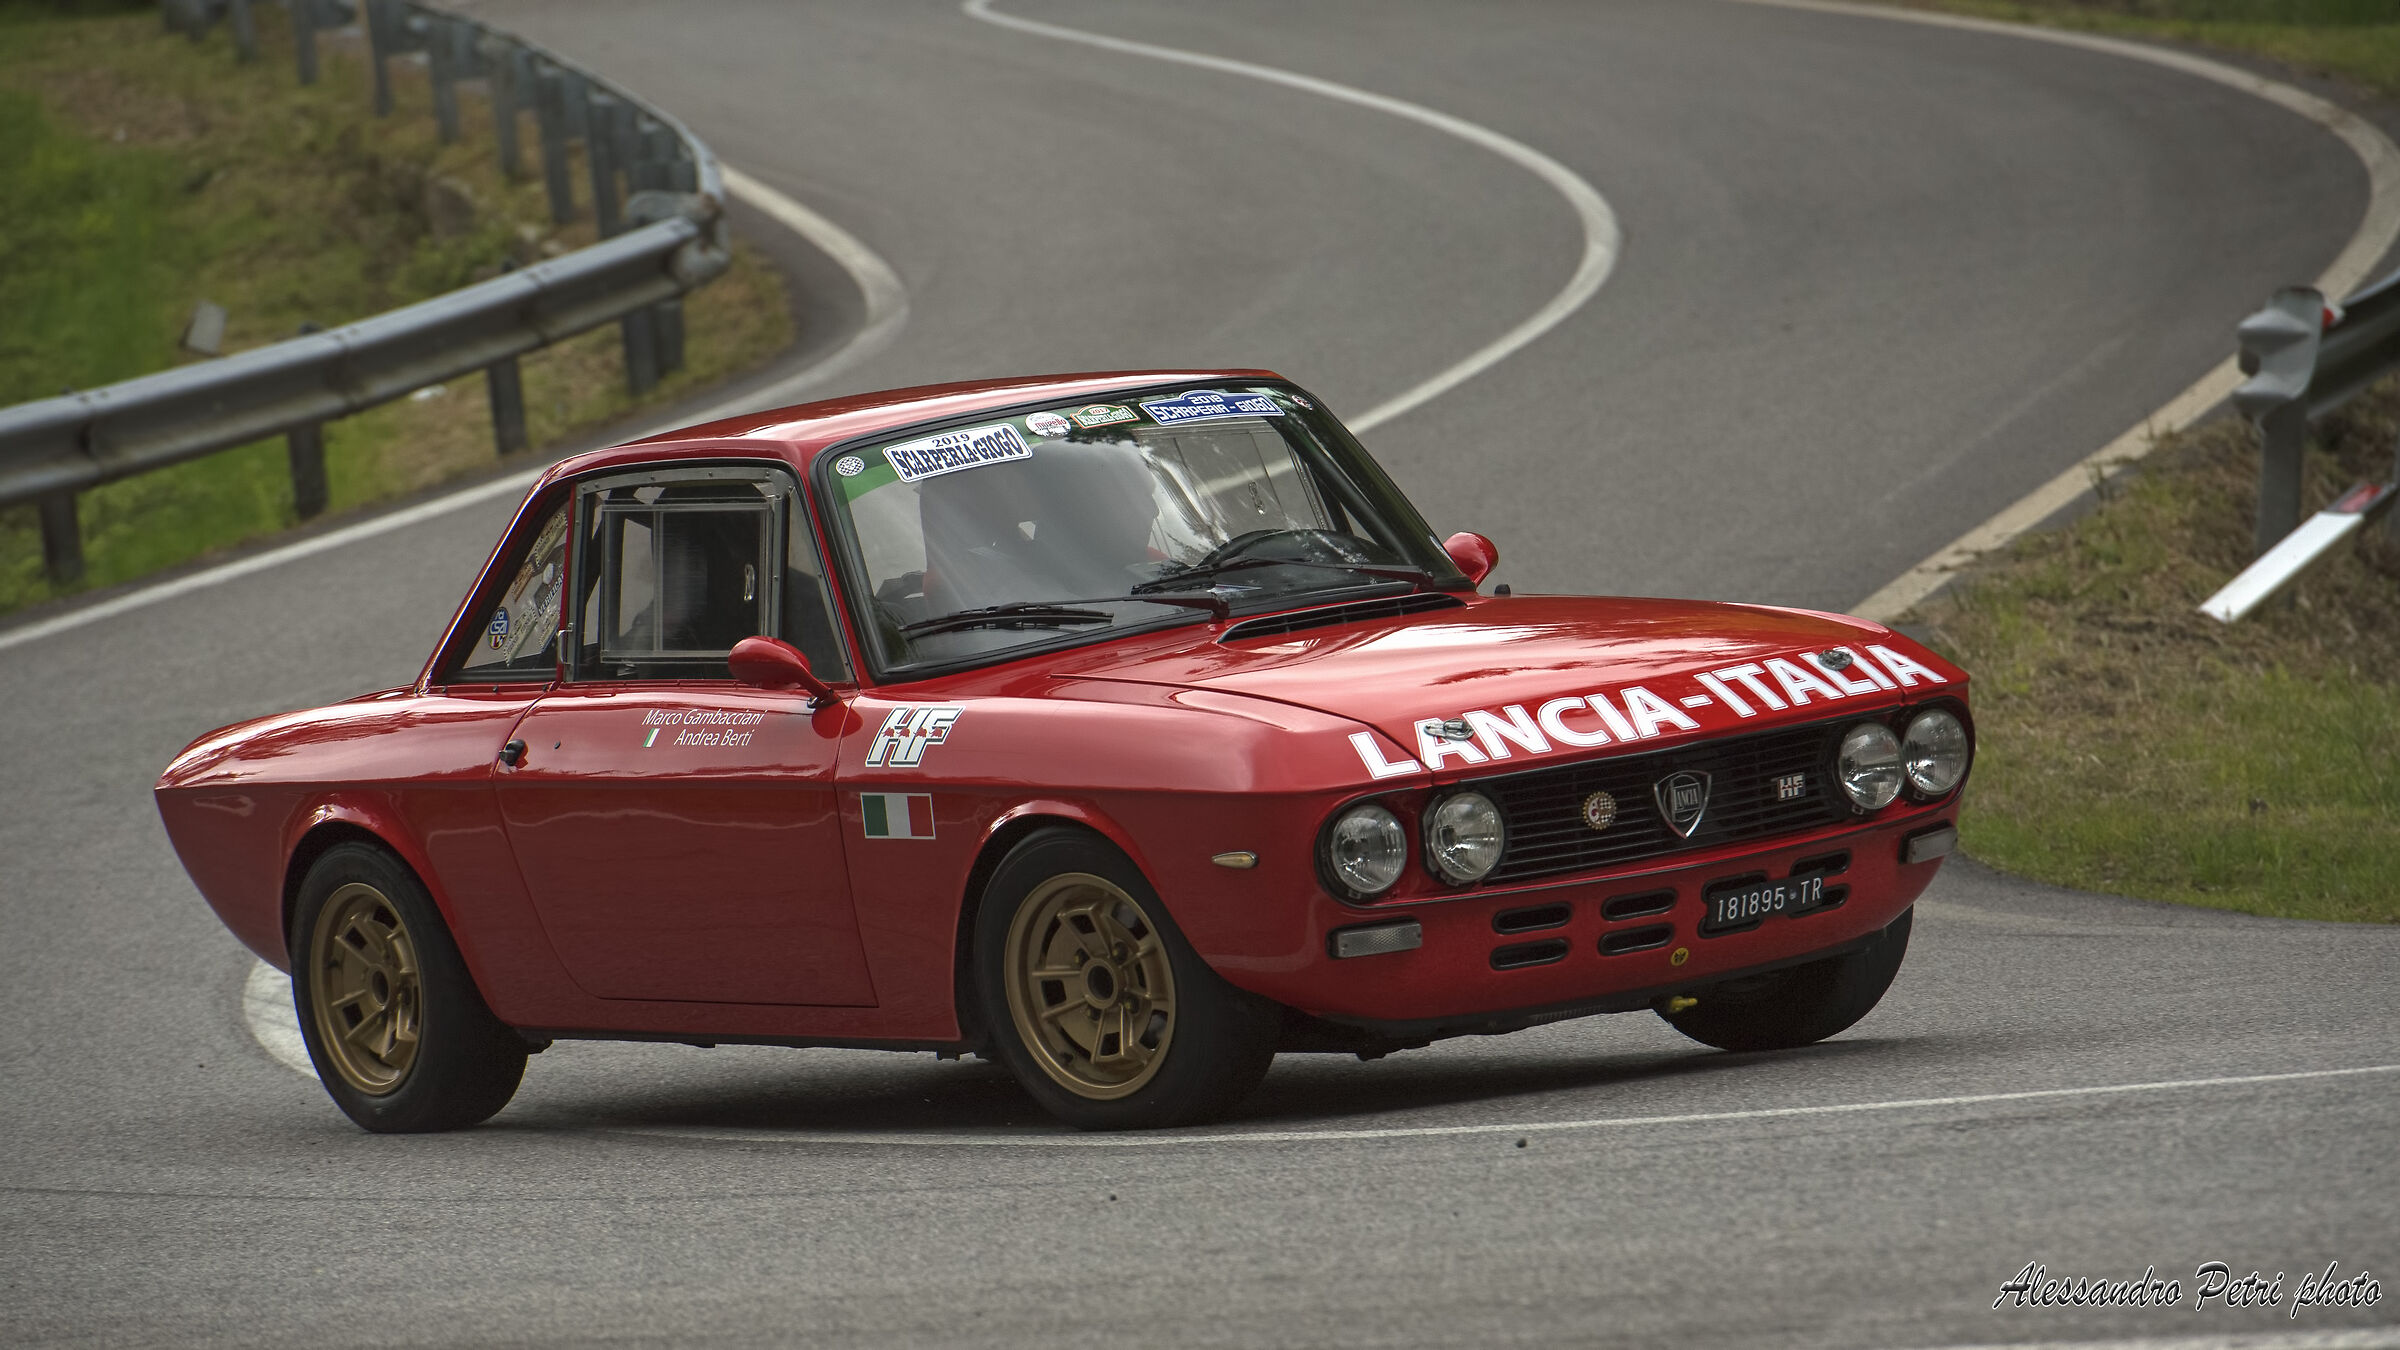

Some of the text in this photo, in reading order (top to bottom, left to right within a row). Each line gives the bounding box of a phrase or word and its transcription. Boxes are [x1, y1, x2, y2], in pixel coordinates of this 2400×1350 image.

[1149, 404, 1230, 421] SCARPERIA
[1235, 397, 1276, 412] GIOGO
[1188, 394, 1224, 405] 2018
[931, 433, 970, 448] 2019
[641, 708, 768, 726] Marco Gambacciani
[1348, 643, 1948, 780] LANCIA-ITALIA
[673, 728, 755, 746] Andrea Berti
[865, 705, 966, 768] HF
[1779, 774, 1804, 799] HF
[1718, 877, 1822, 922] 181895 TR
